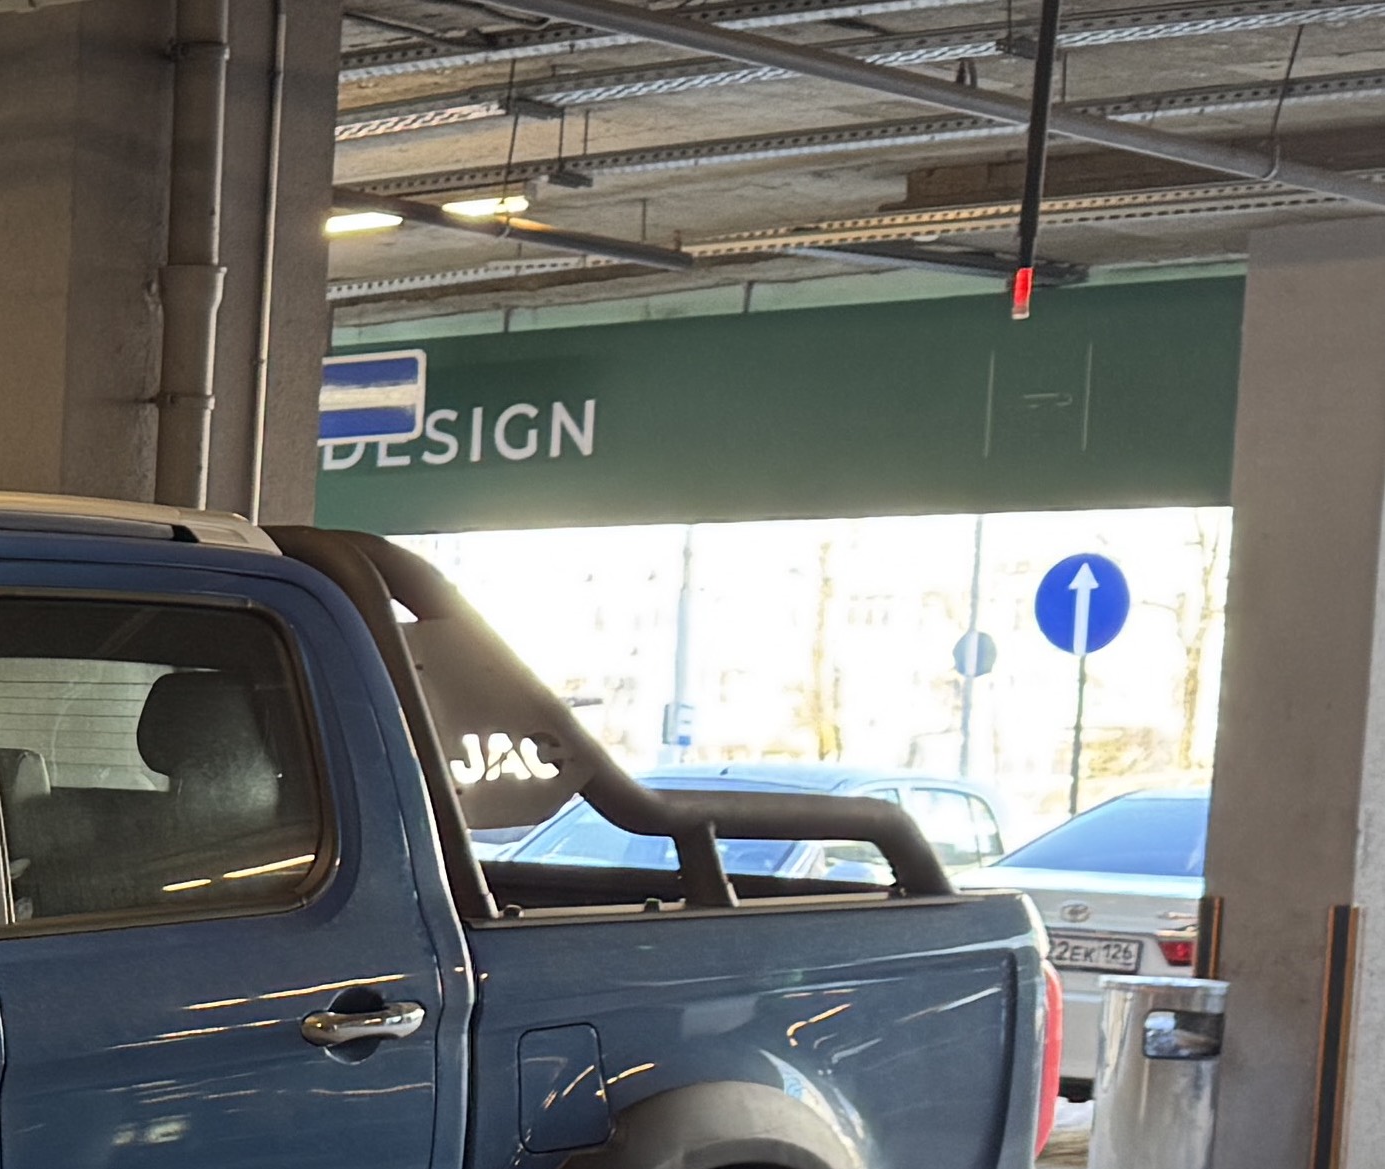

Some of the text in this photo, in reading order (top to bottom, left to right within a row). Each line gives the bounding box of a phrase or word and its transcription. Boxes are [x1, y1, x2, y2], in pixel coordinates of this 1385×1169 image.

[450, 732, 560, 784] JAC
[1049, 940, 1133, 963] 2ЕК 126
